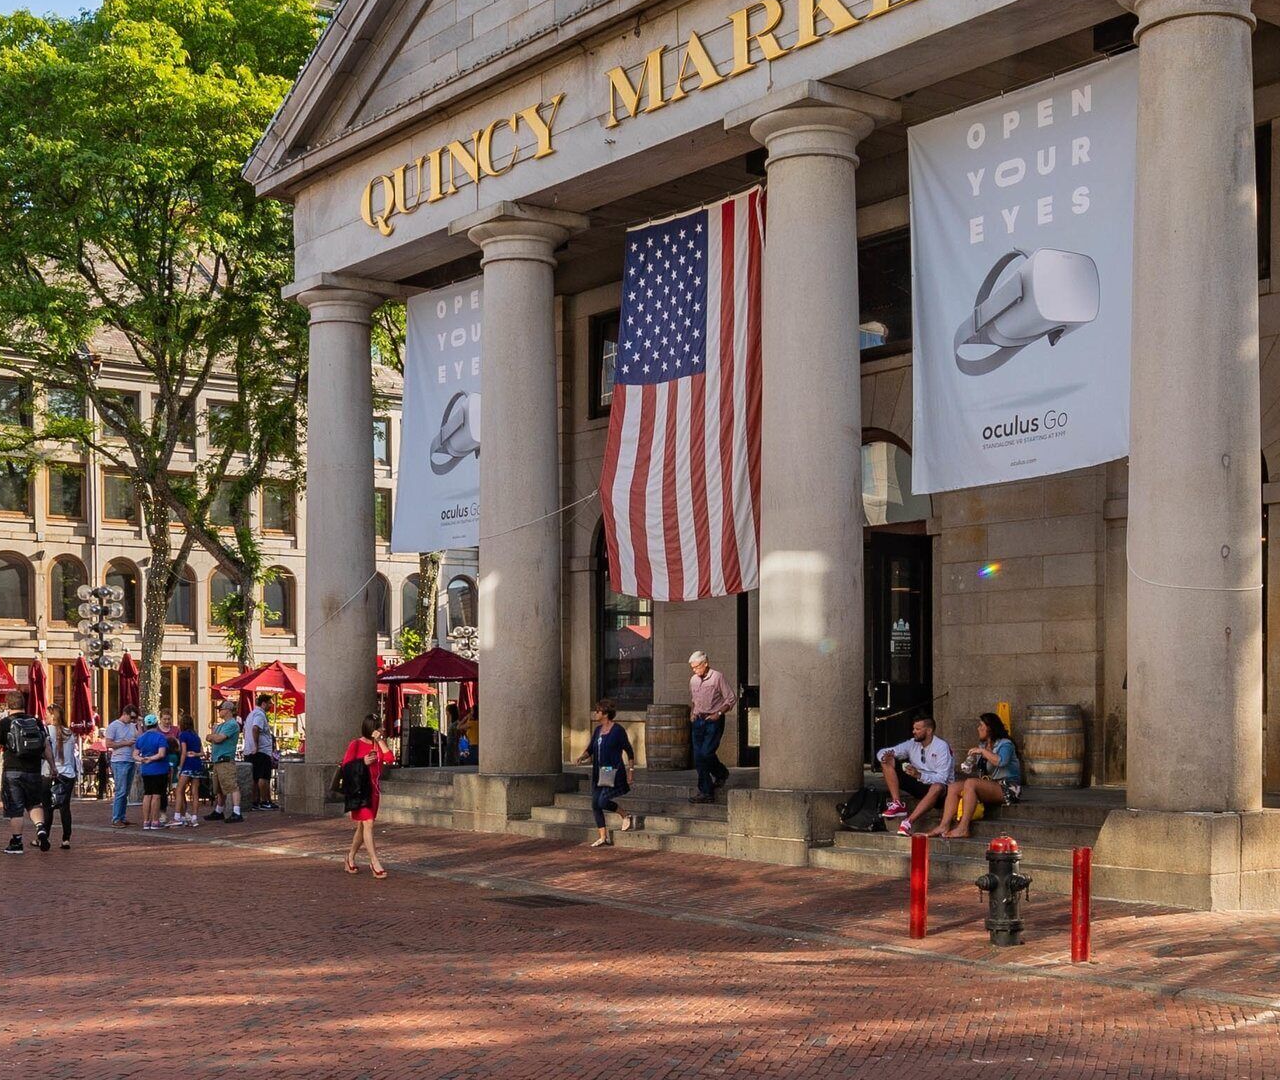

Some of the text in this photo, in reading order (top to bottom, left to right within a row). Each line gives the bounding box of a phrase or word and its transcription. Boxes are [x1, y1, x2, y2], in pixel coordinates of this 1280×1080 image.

[966, 84, 1092, 150] OPEN
[360, 92, 567, 237] QUINCY
[966, 136, 1092, 197] YOUR
[970, 186, 1091, 244] EYES
[436, 289, 480, 319] OPE
[437, 322, 481, 352] YOU
[438, 356, 481, 384] EYE
[982, 409, 1068, 440] oculus Go
[440, 503, 469, 520] oculus
